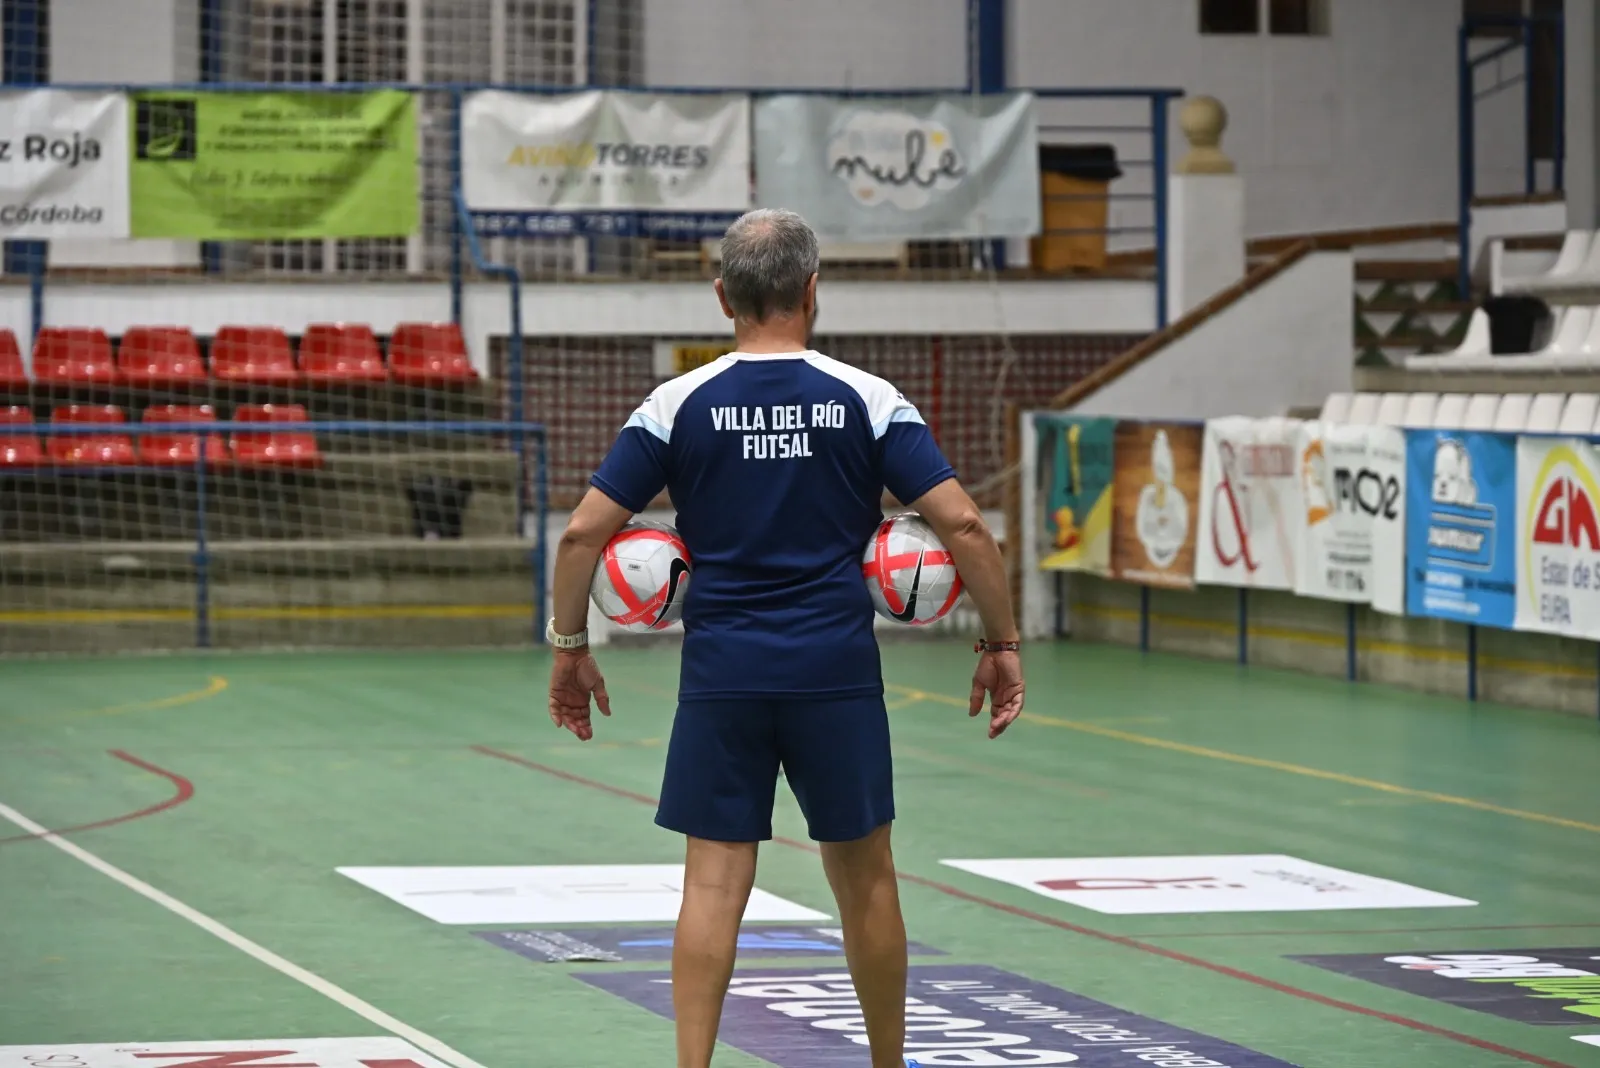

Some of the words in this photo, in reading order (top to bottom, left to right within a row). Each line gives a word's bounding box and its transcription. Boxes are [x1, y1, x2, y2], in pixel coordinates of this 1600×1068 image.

[24, 131, 102, 169] Roja
[830, 129, 968, 188] nube
[0, 203, 104, 226] Córdoba
[710, 406, 767, 431] VILLA
[772, 405, 806, 430] DEL
[811, 399, 846, 429] RÍO
[742, 432, 813, 460] FUTSAL
[919, 979, 995, 992] TV
[967, 992, 1084, 1020] MÓVIL
[648, 973, 1081, 1068] econet
[1050, 1022, 1152, 1042] FIJO
